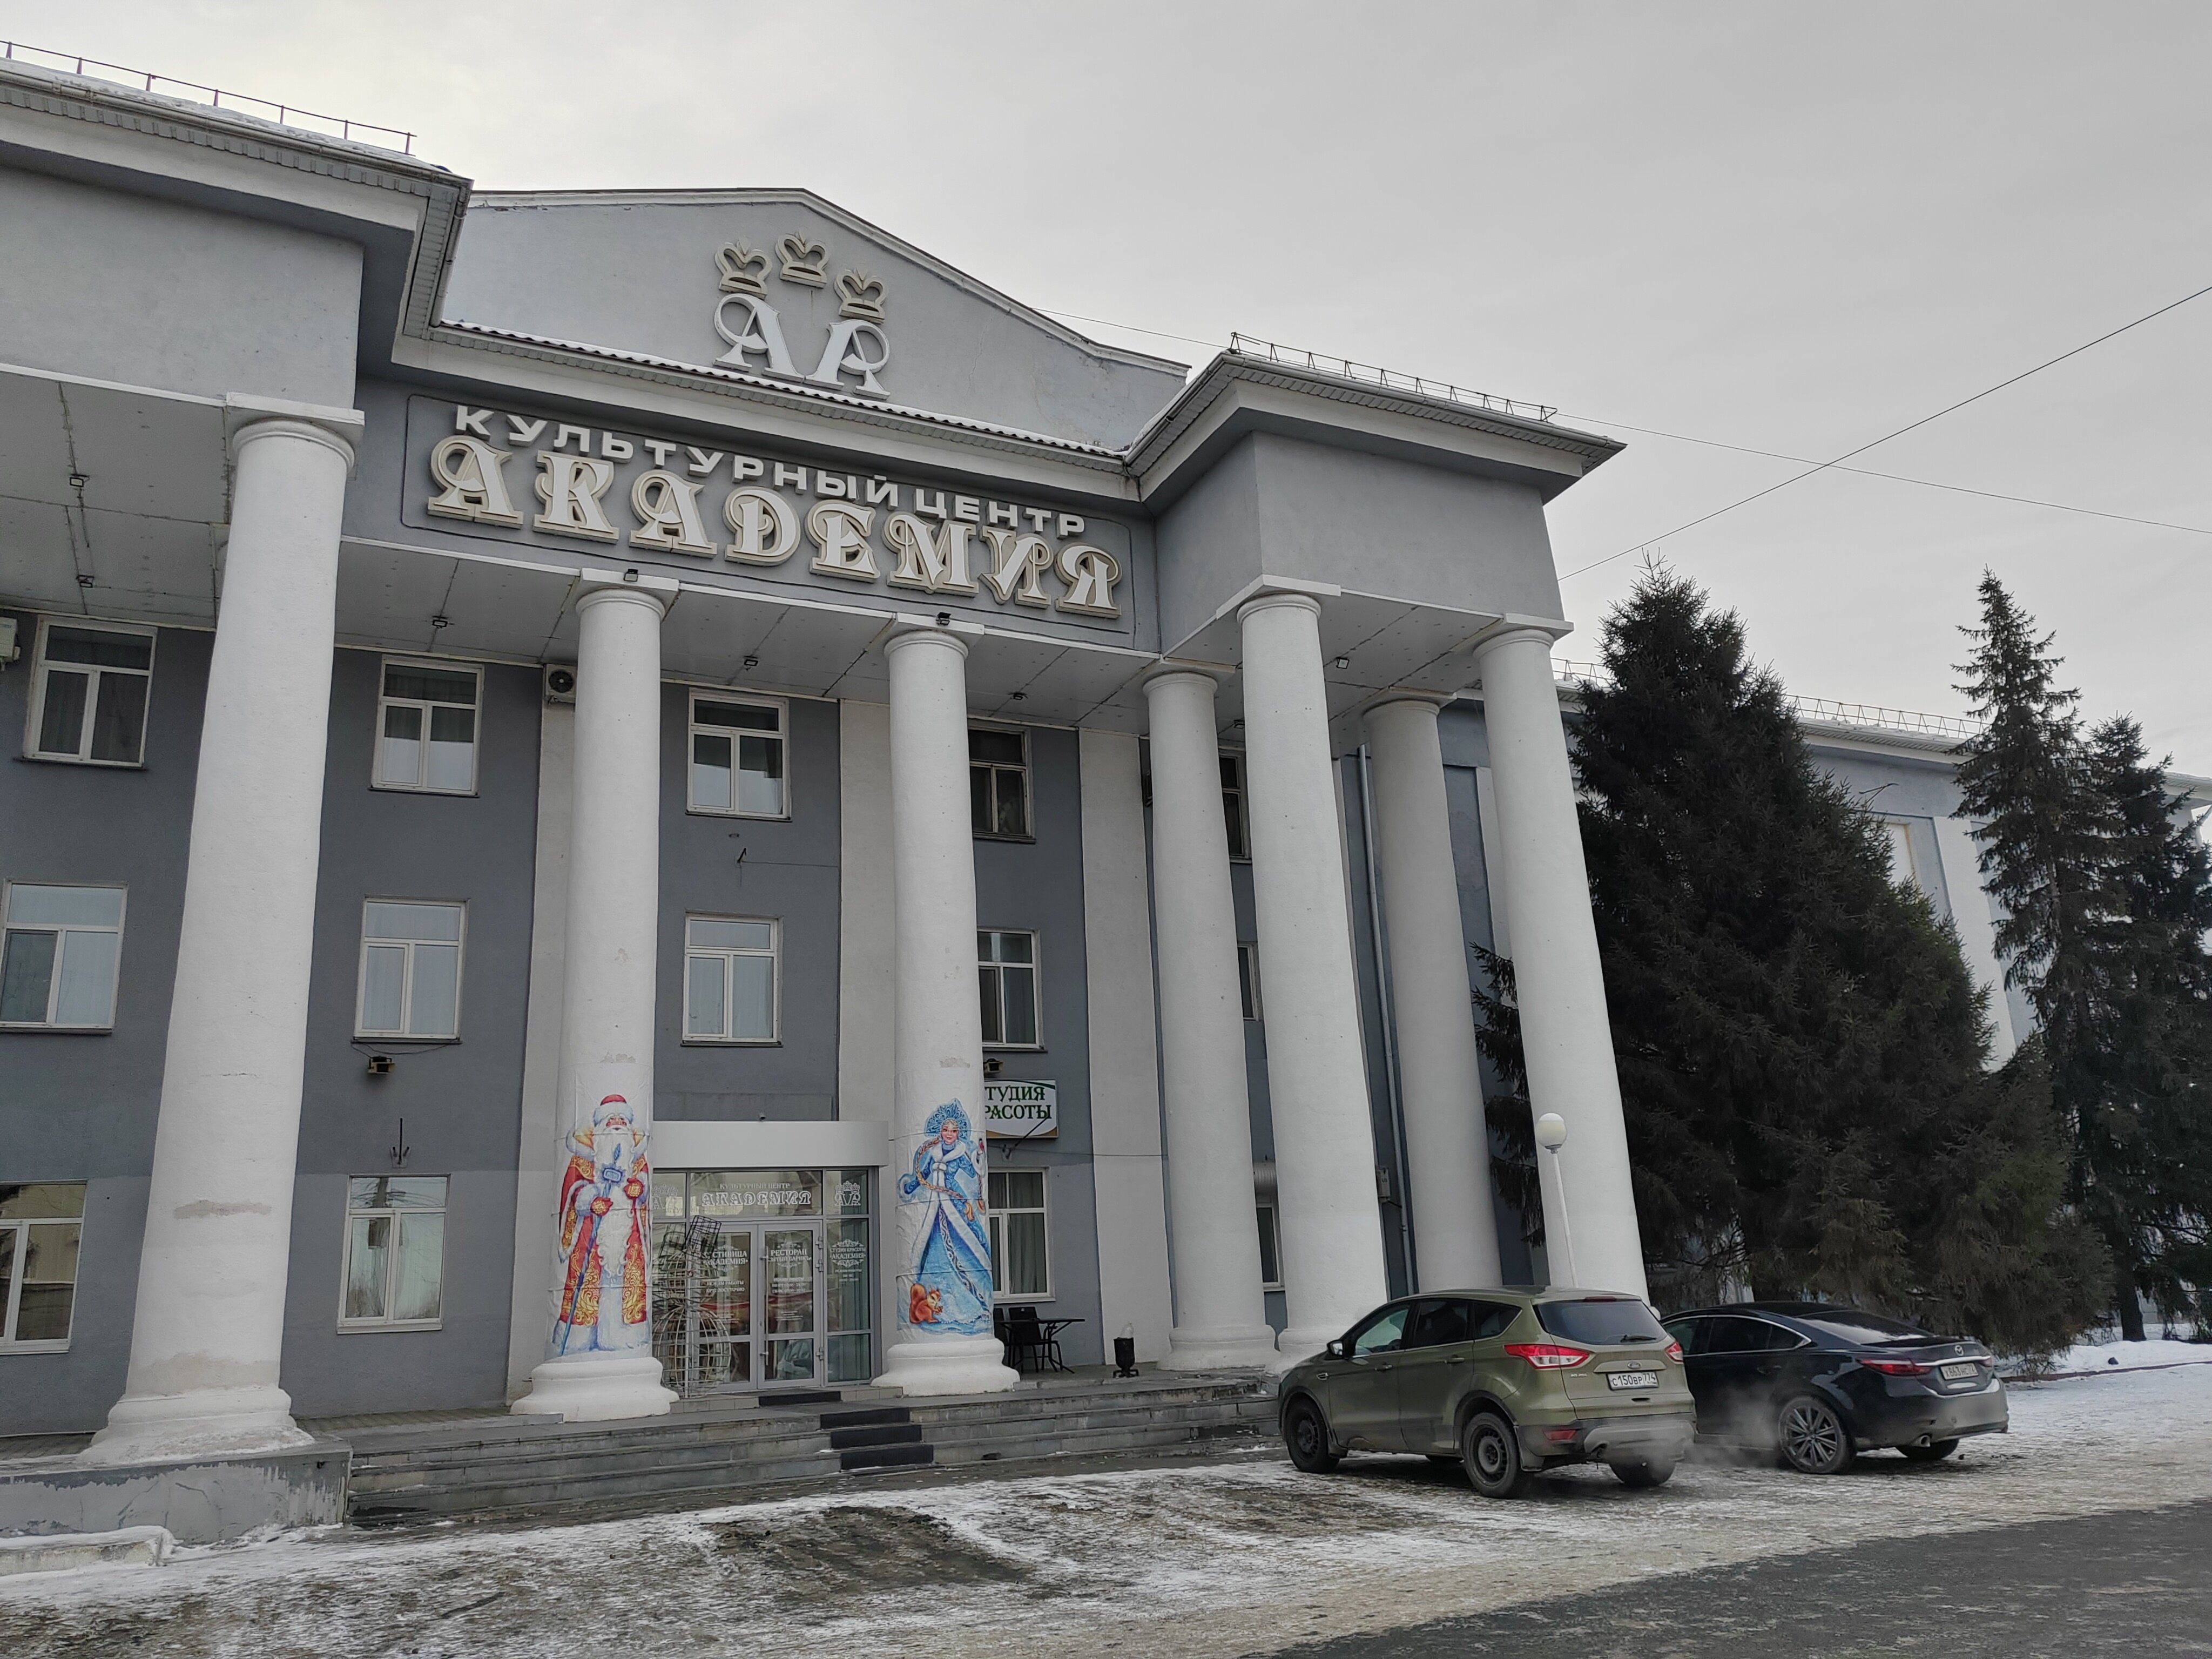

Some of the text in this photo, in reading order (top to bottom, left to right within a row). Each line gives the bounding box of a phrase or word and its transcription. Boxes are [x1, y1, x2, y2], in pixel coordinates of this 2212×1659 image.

[456, 405, 1085, 539] КУЛЬТУРНЫЙ ЦЕНТР
[984, 1085, 1046, 1102] ТУДИЯ
[984, 1104, 1052, 1120] РАСОТЫ
